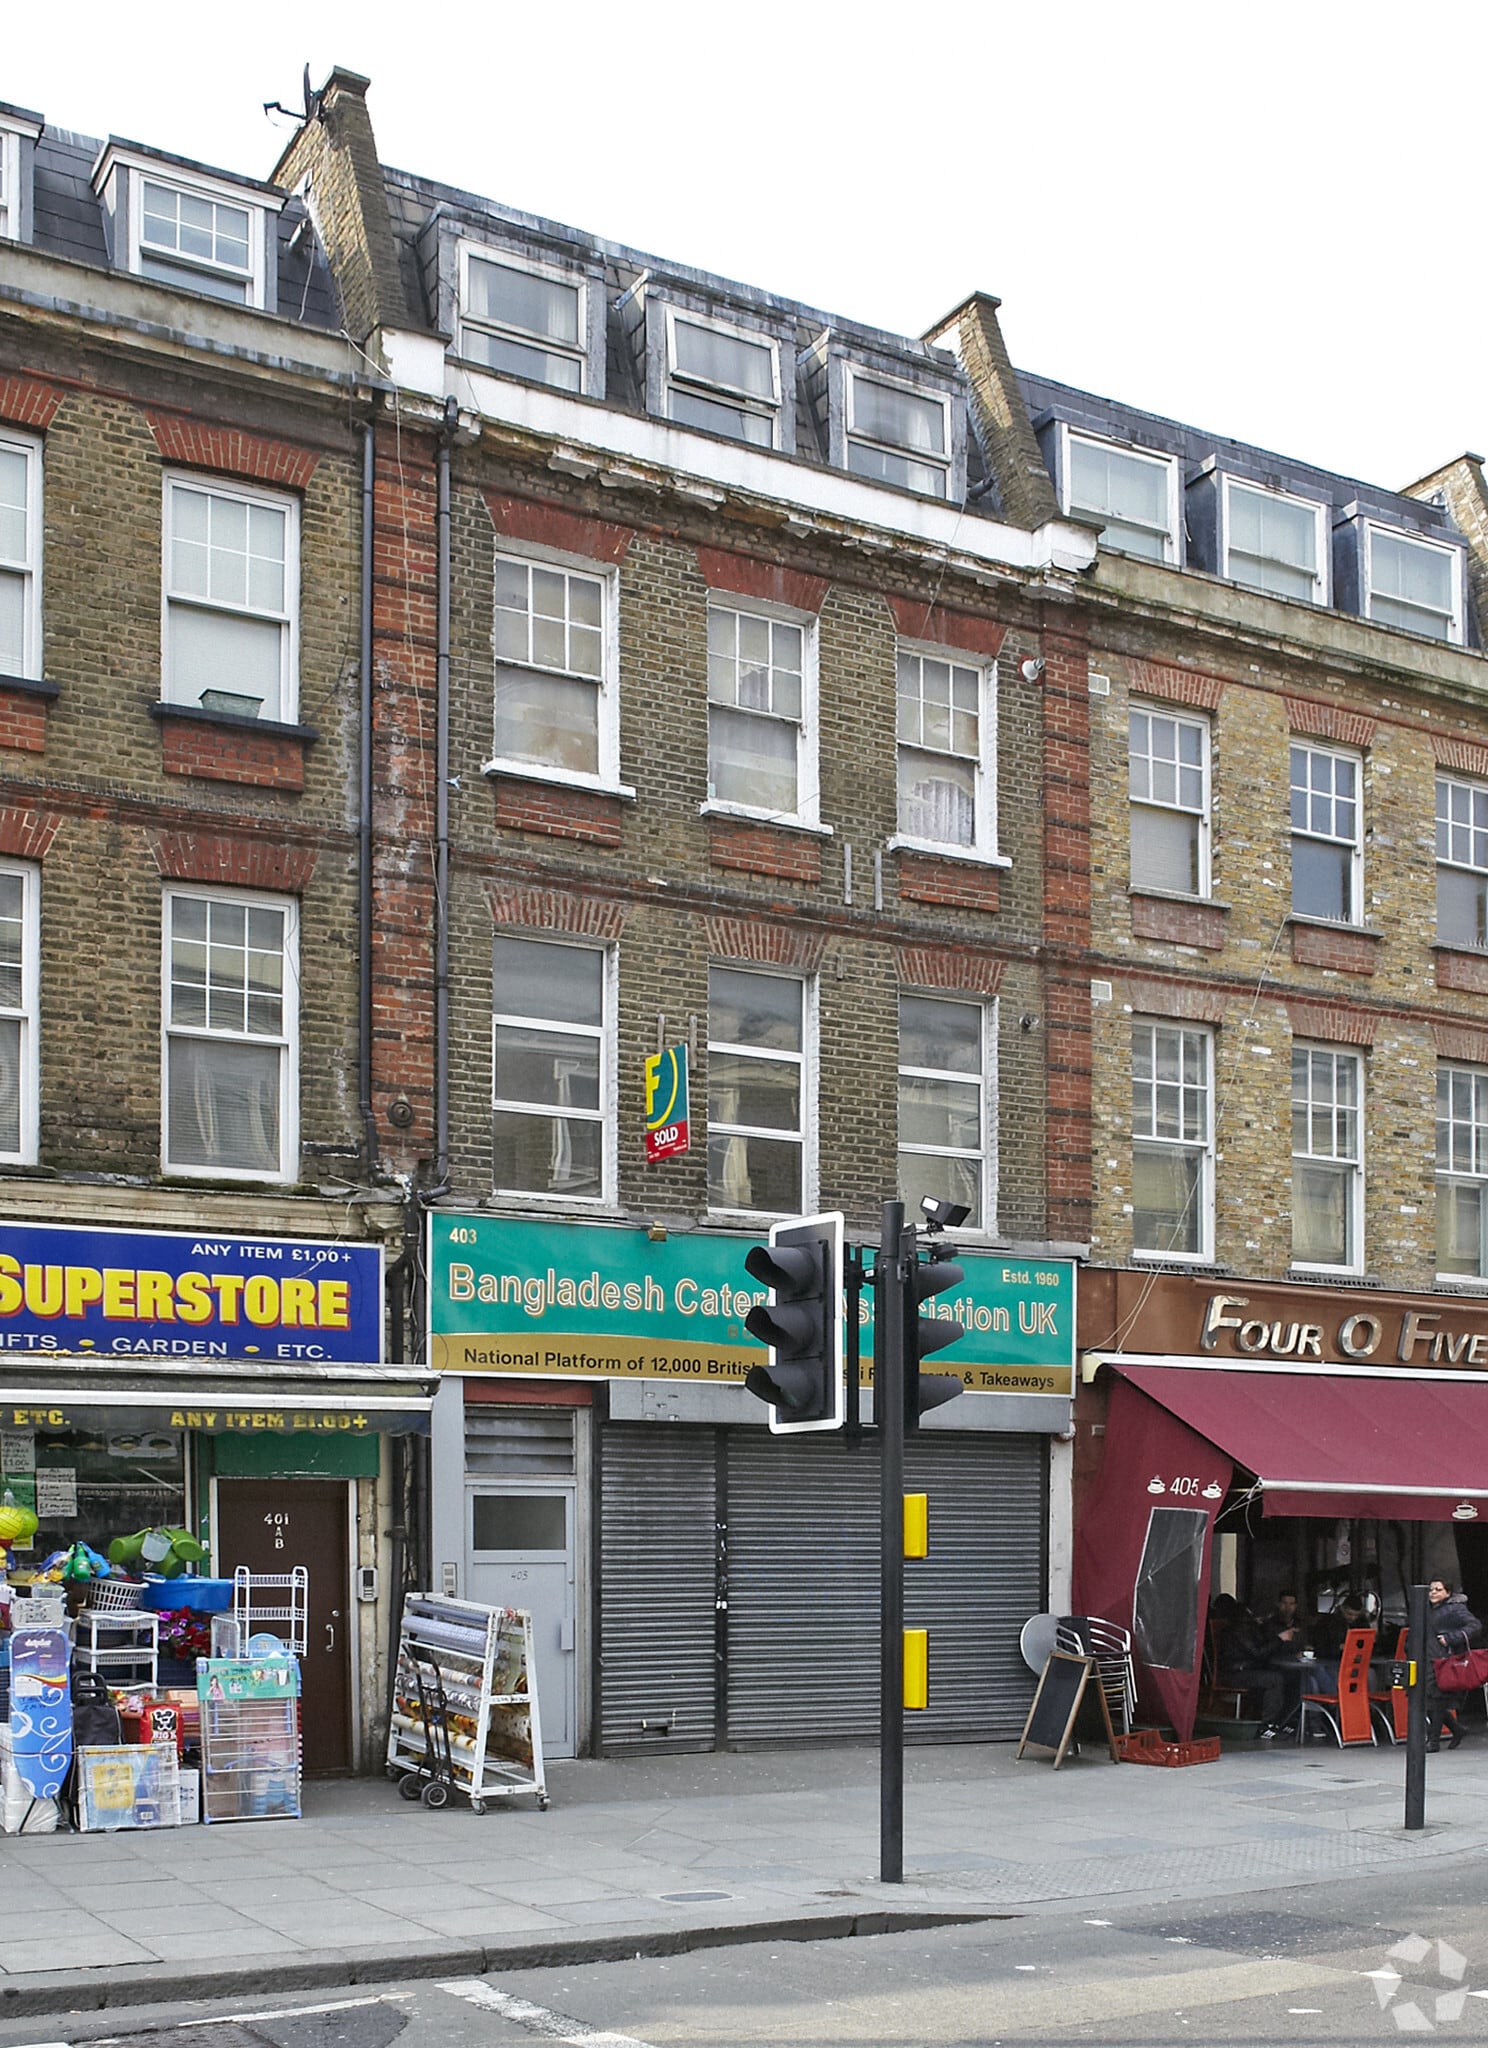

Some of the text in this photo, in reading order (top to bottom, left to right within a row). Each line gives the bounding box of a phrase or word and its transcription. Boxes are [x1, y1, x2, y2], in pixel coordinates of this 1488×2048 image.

[654, 1127, 679, 1147] SOLD
[449, 1227, 477, 1244] 403
[191, 1243, 232, 1257] ANY
[239, 1245, 283, 1260] ITEM
[1002, 1269, 1059, 1287] Estd. 1960
[0, 1253, 351, 1330] SUPERSTORE
[449, 1262, 665, 1317] Bangladesh
[675, 1278, 770, 1318] Cater
[1019, 1302, 1059, 1336] UK
[1201, 1295, 1325, 1356] FOUR
[111, 1337, 228, 1355] GARDEN
[277, 1343, 332, 1359] ETC.
[464, 1347, 540, 1368] National
[545, 1352, 621, 1371] Platform
[627, 1355, 644, 1371] of
[651, 1357, 701, 1374] 12,000
[707, 1360, 757, 1377] Britis
[963, 1371, 974, 1385] &
[979, 1371, 1055, 1388] Takeaways
[13, 1409, 71, 1425] ETC.
[170, 1411, 217, 1427] ANY
[225, 1413, 285, 1428] ITEM
[1169, 1476, 1199, 1496] 405
[263, 1513, 290, 1525] 401
[275, 1526, 283, 1537] A
[275, 1538, 284, 1549] B
